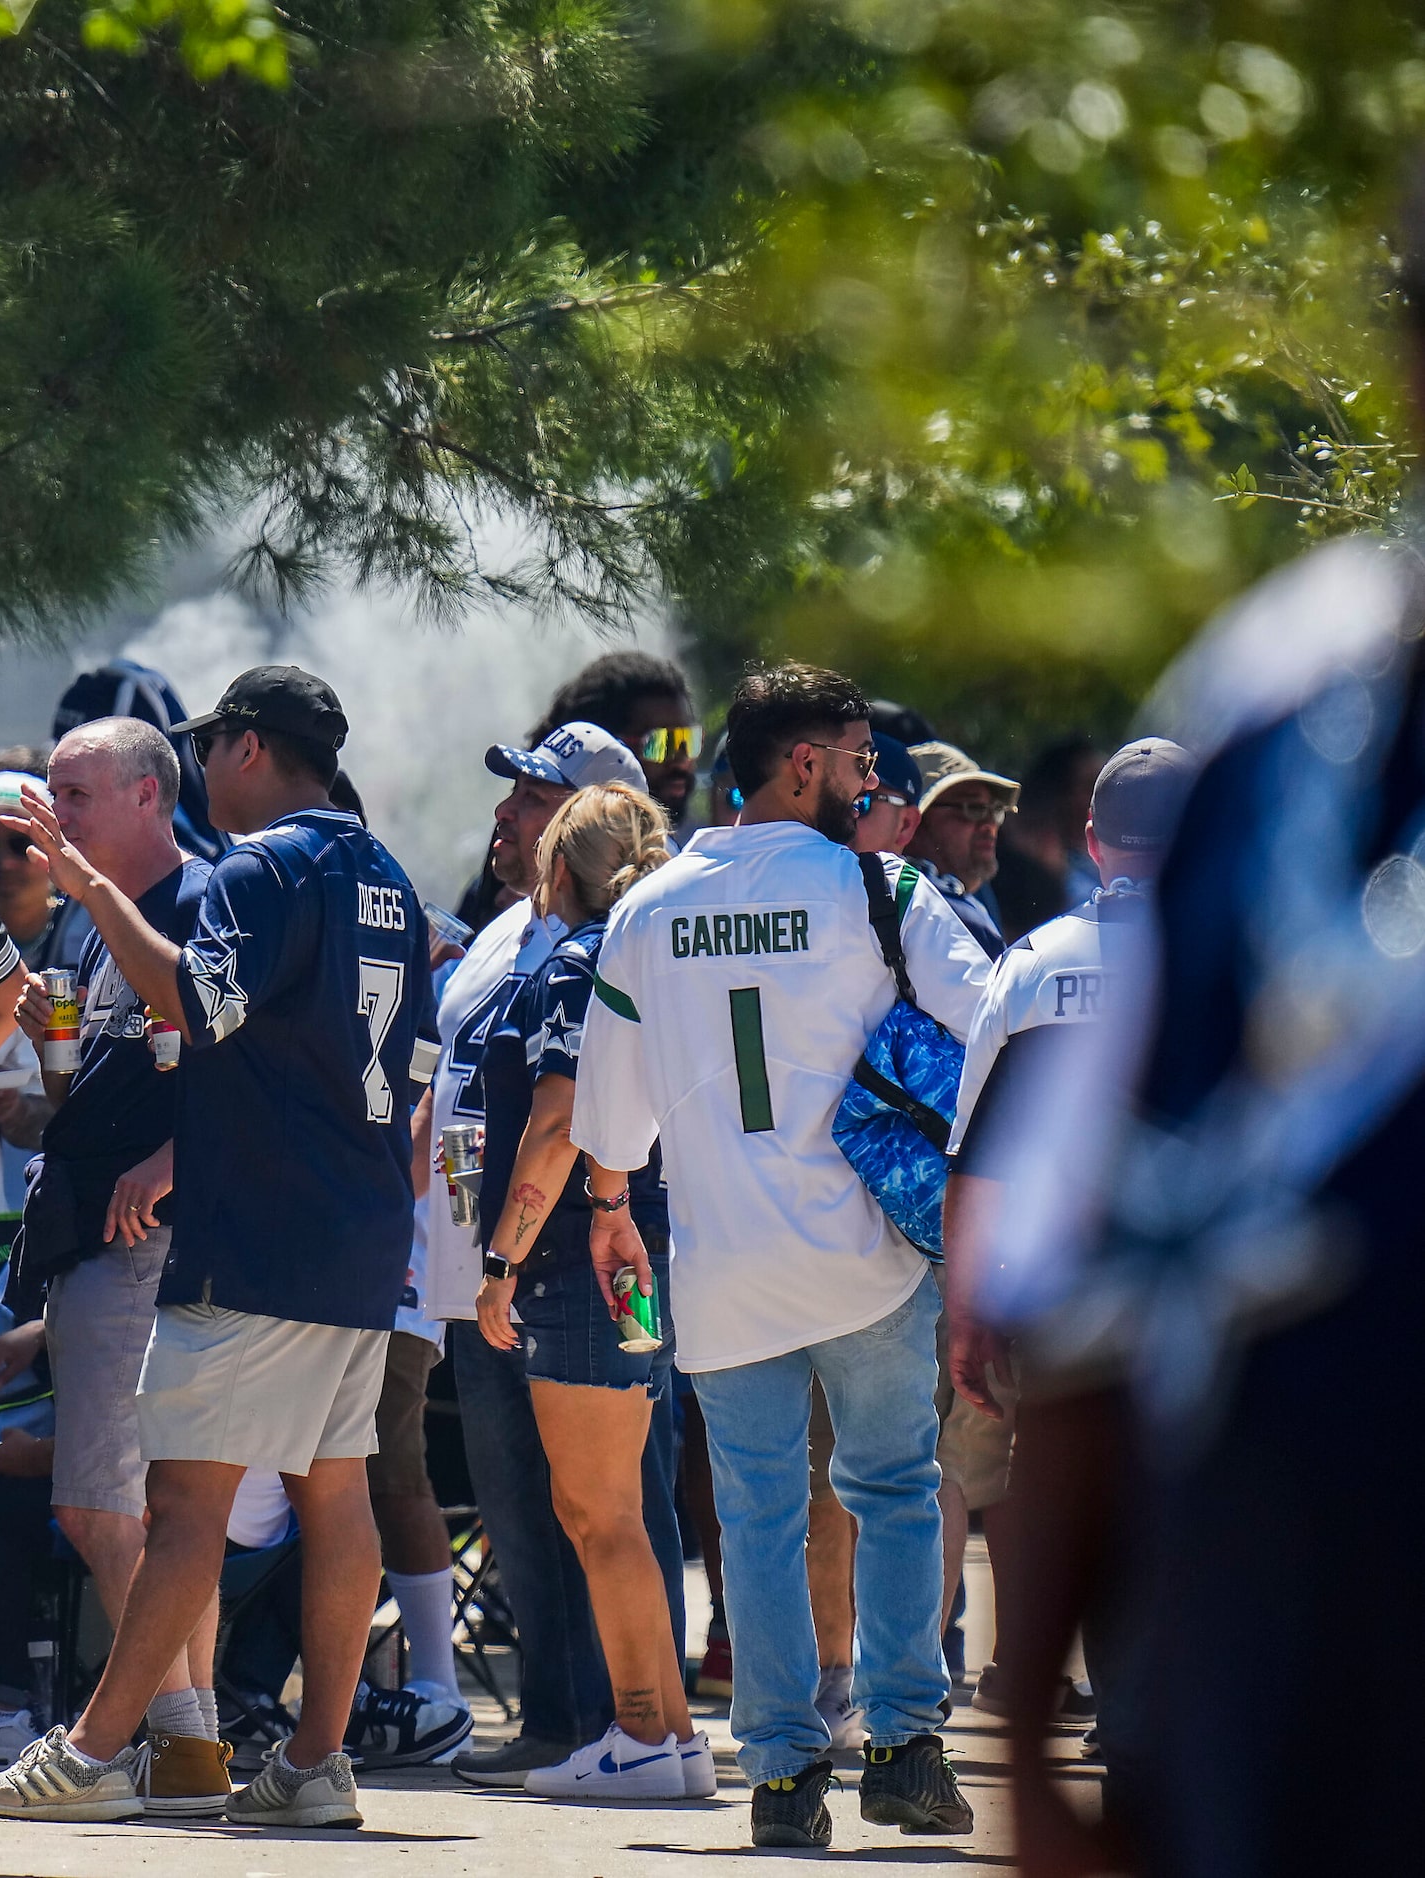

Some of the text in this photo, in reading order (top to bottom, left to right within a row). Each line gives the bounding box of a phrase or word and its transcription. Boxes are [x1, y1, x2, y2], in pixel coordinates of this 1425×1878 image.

[357, 881, 405, 930] DIGGS
[672, 910, 809, 959] GARDNER
[357, 956, 404, 1123] 7
[1055, 974, 1110, 1017] PR
[449, 973, 528, 1119] 4
[729, 987, 775, 1134] 1
